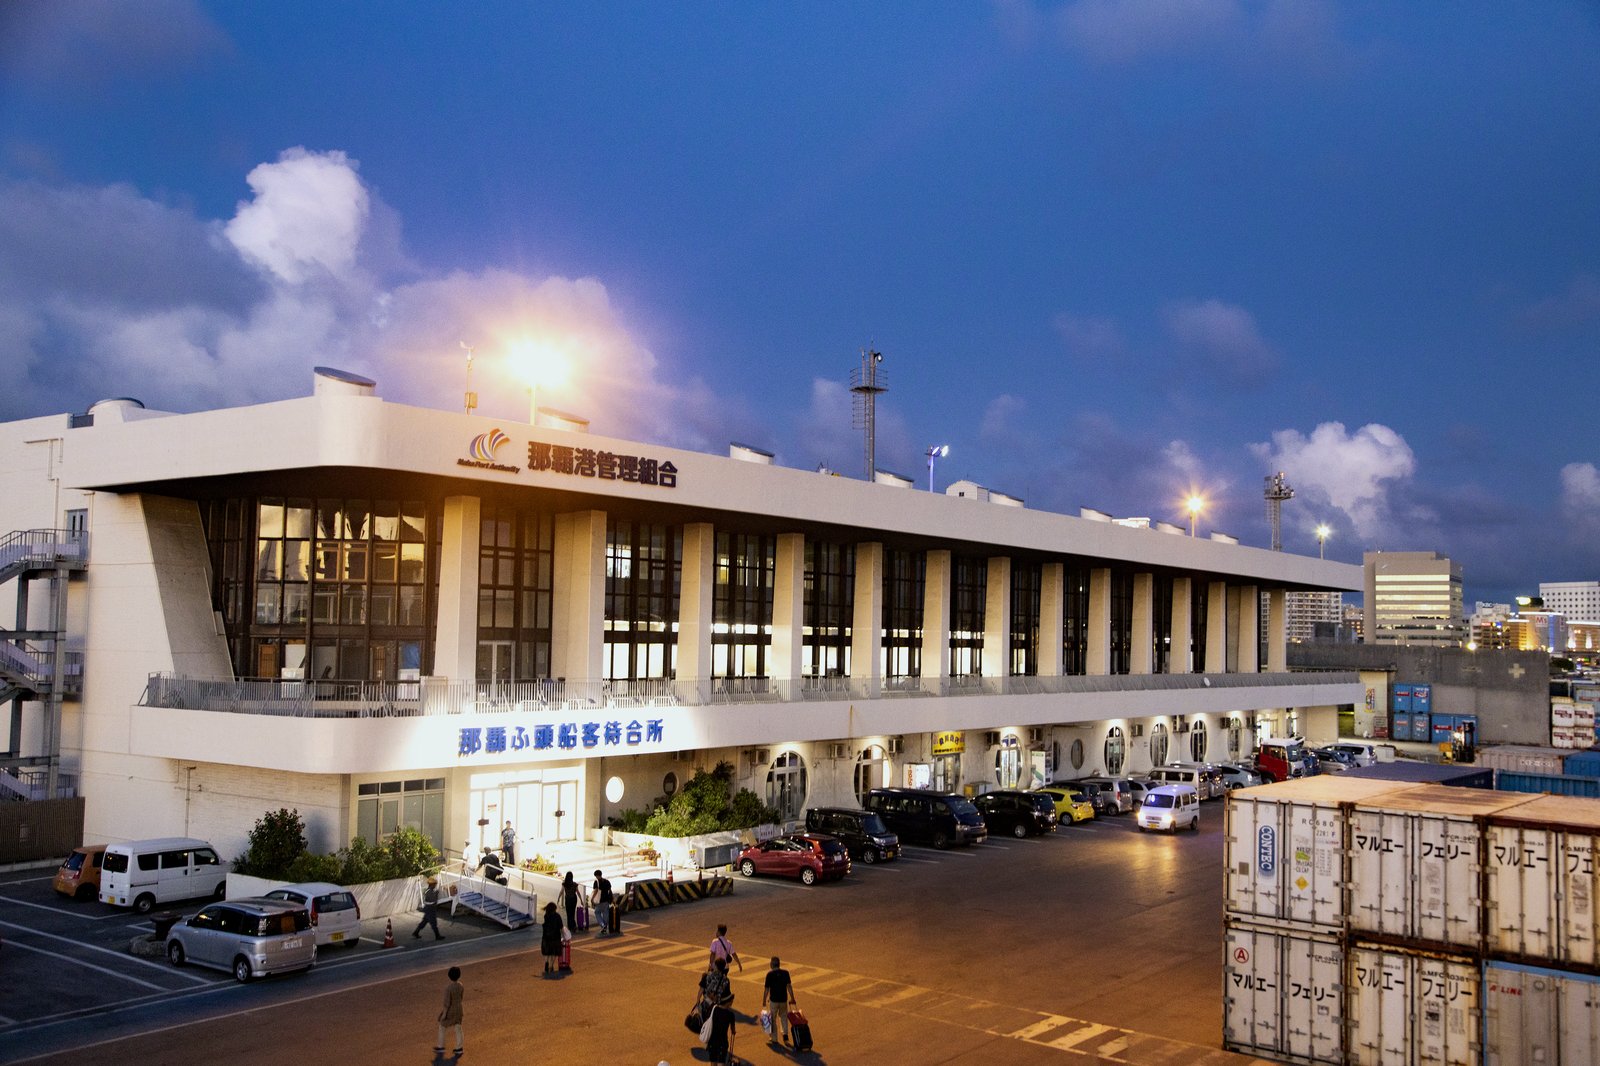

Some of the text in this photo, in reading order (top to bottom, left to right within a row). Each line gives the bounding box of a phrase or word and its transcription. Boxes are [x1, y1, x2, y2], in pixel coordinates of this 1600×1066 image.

[528, 441, 678, 488] 那覇港管理組合
[458, 719, 664, 757] 那覇ふ頭船客待合所
[1261, 826, 1273, 870] CONTEC
[1355, 835, 1471, 860] マルエー フェリー
[1494, 846, 1548, 868] マルエー
[1232, 973, 1336, 1001] マルエー フェリー
[1356, 967, 1473, 1002] マルエー フェリー
